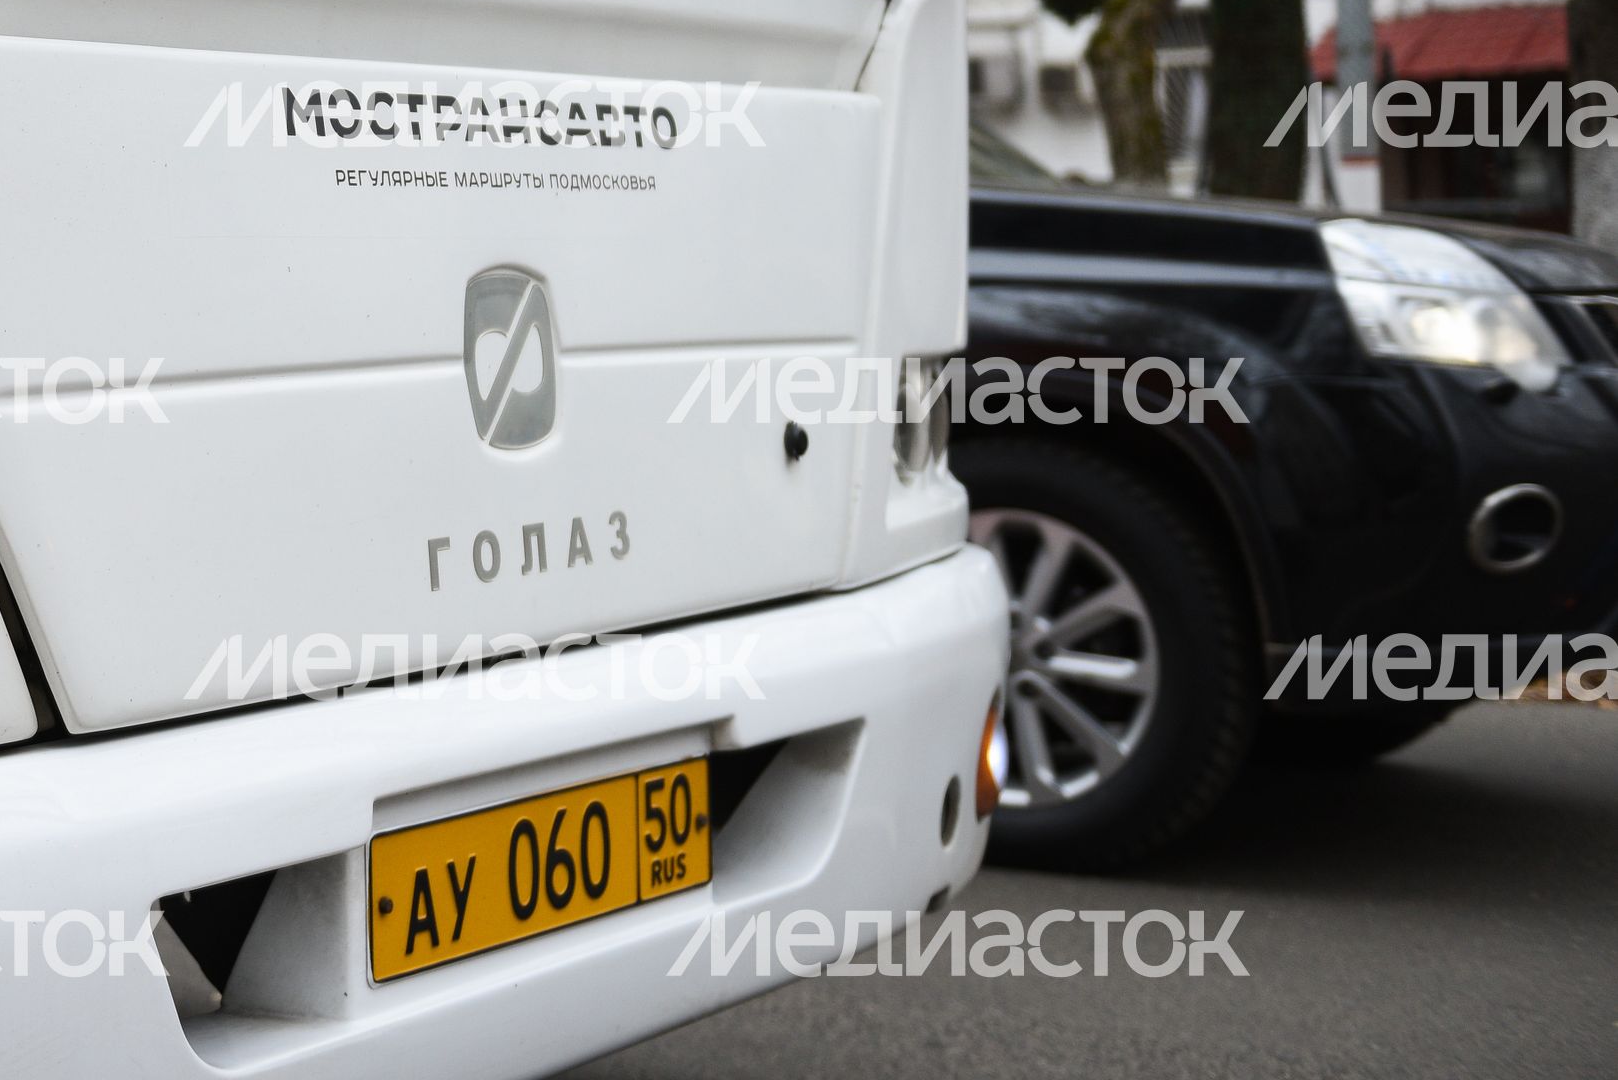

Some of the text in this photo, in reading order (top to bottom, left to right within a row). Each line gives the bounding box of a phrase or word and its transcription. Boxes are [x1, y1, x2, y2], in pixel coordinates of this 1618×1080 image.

[281, 86, 678, 150] МОСТРАНСАВТО
[335, 168, 657, 192] РЕГУЛЯРНЫЕ МАРШРУТЫ ПОДМОСКОВЬЯ
[427, 510, 631, 592] ГОЛАЗ
[644, 773, 692, 853] 50
[508, 800, 612, 921] 060
[651, 853, 688, 888] RUS
